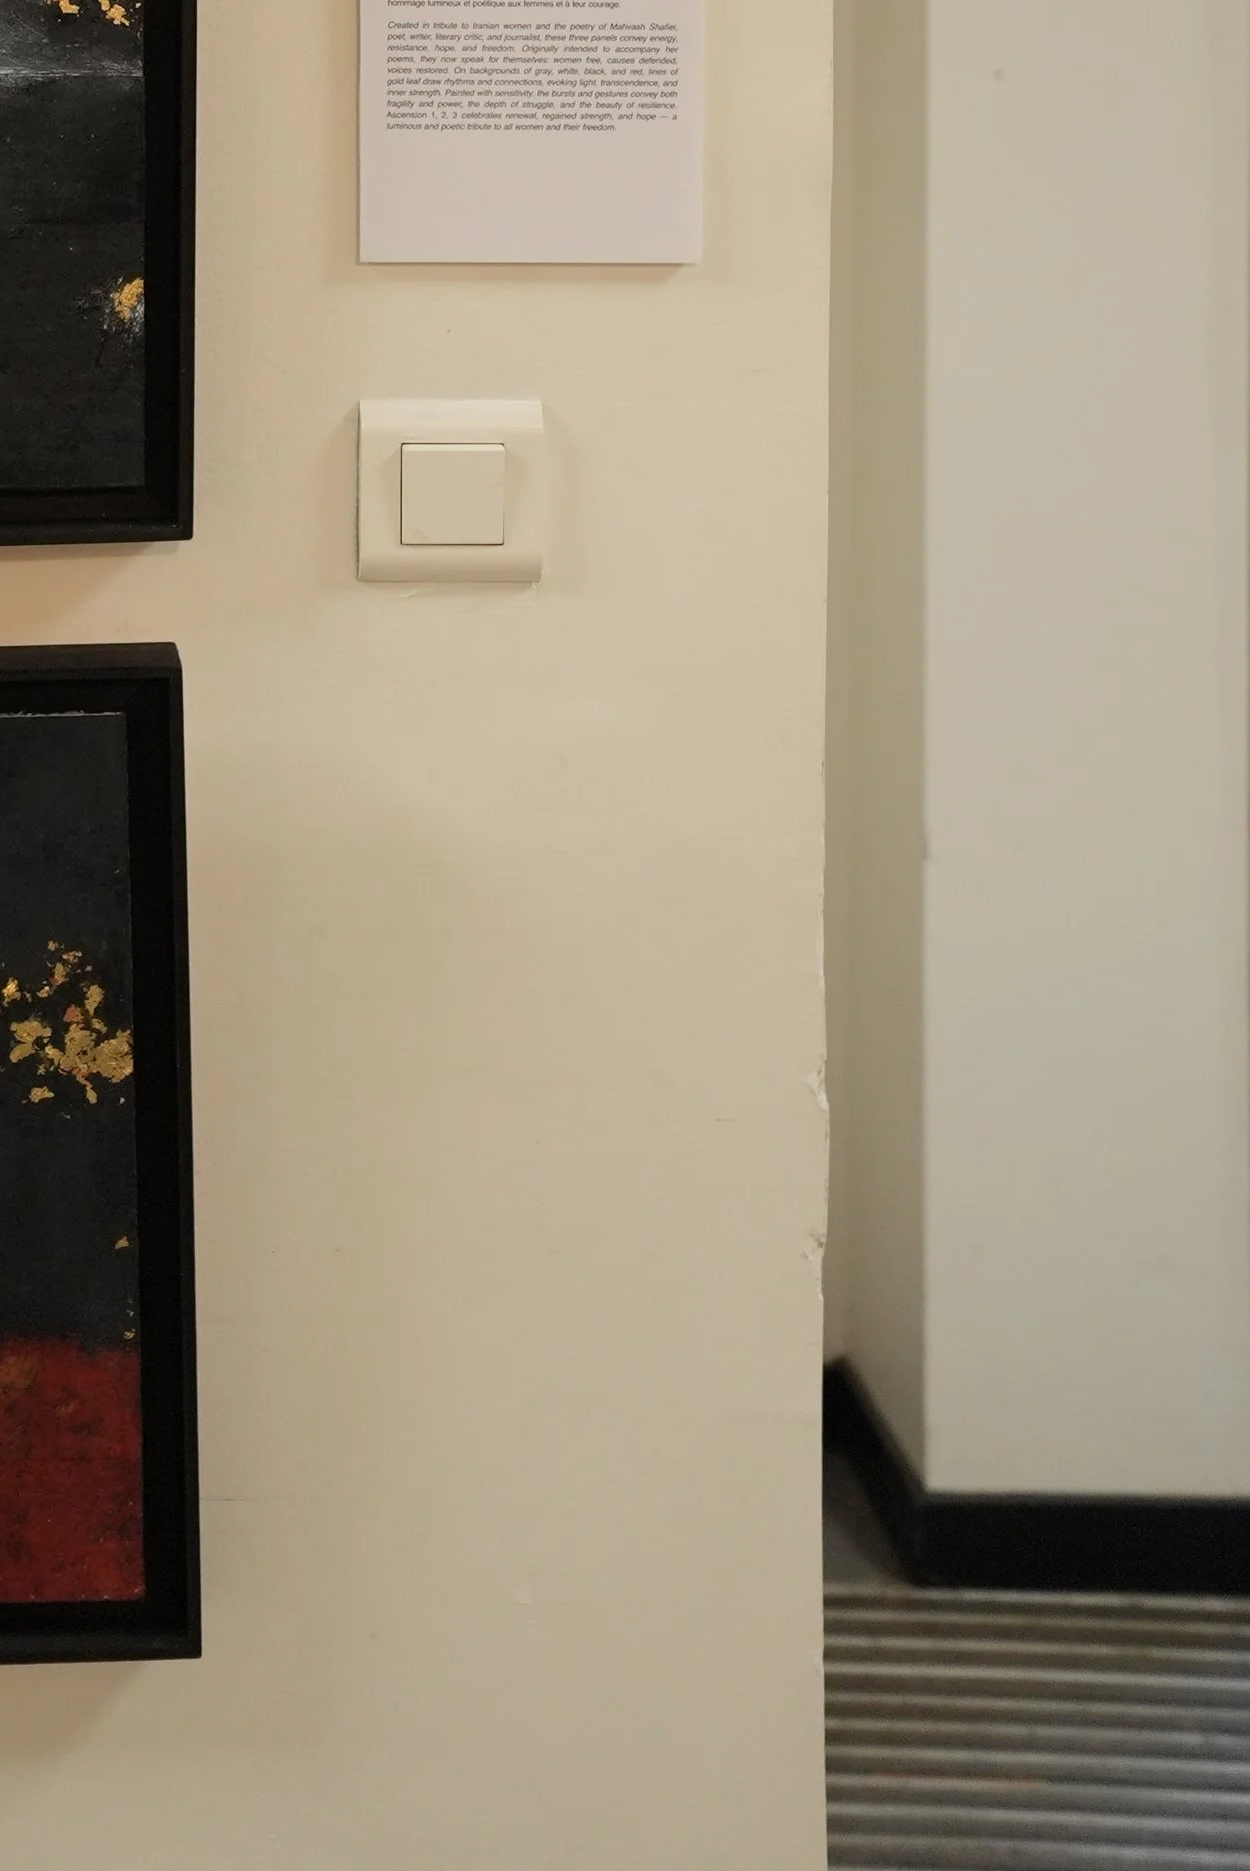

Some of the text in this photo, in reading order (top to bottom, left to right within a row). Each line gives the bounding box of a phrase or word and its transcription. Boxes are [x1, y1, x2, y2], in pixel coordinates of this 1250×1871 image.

[523, 0, 553, 7] femmes
[555, 0, 563, 7] et
[565, 0, 570, 7] à
[572, 0, 585, 7] leur
[387, 21, 419, 29] Created
[422, 21, 429, 29] in
[432, 21, 457, 29] tribute
[461, 21, 469, 30] to
[472, 21, 499, 30] Iranian
[535, 22, 550, 30] and
[554, 22, 566, 30] the
[569, 22, 595, 32] poetry
[598, 22, 606, 30] of
[609, 22, 645, 30] Mahvash
[435, 32, 461, 42] literary
[487, 33, 502, 41] and
[544, 33, 566, 41] these
[568, 33, 588, 41] three
[591, 33, 617, 43] panels
[619, 35, 647, 43] convey
[462, 44, 477, 52] and
[521, 44, 558, 54] Originally
[563, 44, 598, 52] intended
[602, 44, 610, 52] to
[615, 46, 660, 54] accompany
[665, 44, 678, 53] her
[420, 54, 436, 64] they
[461, 55, 484, 65] speak
[488, 55, 498, 63] for
[387, 77, 404, 87] gold
[406, 77, 420, 85] leaf
[422, 77, 441, 85] draw
[444, 77, 475, 87] rhythms
[477, 77, 492, 85] and
[546, 78, 577, 88] evoking
[663, 79, 677, 87] and
[386, 88, 406, 96] inner
[445, 88, 474, 97] Painted
[477, 89, 492, 97] with
[537, 89, 549, 97] the
[551, 89, 575, 97] bursts
[578, 89, 593, 97] and
[594, 89, 628, 99] gestures
[630, 91, 658, 99] convey
[660, 89, 677, 98] both
